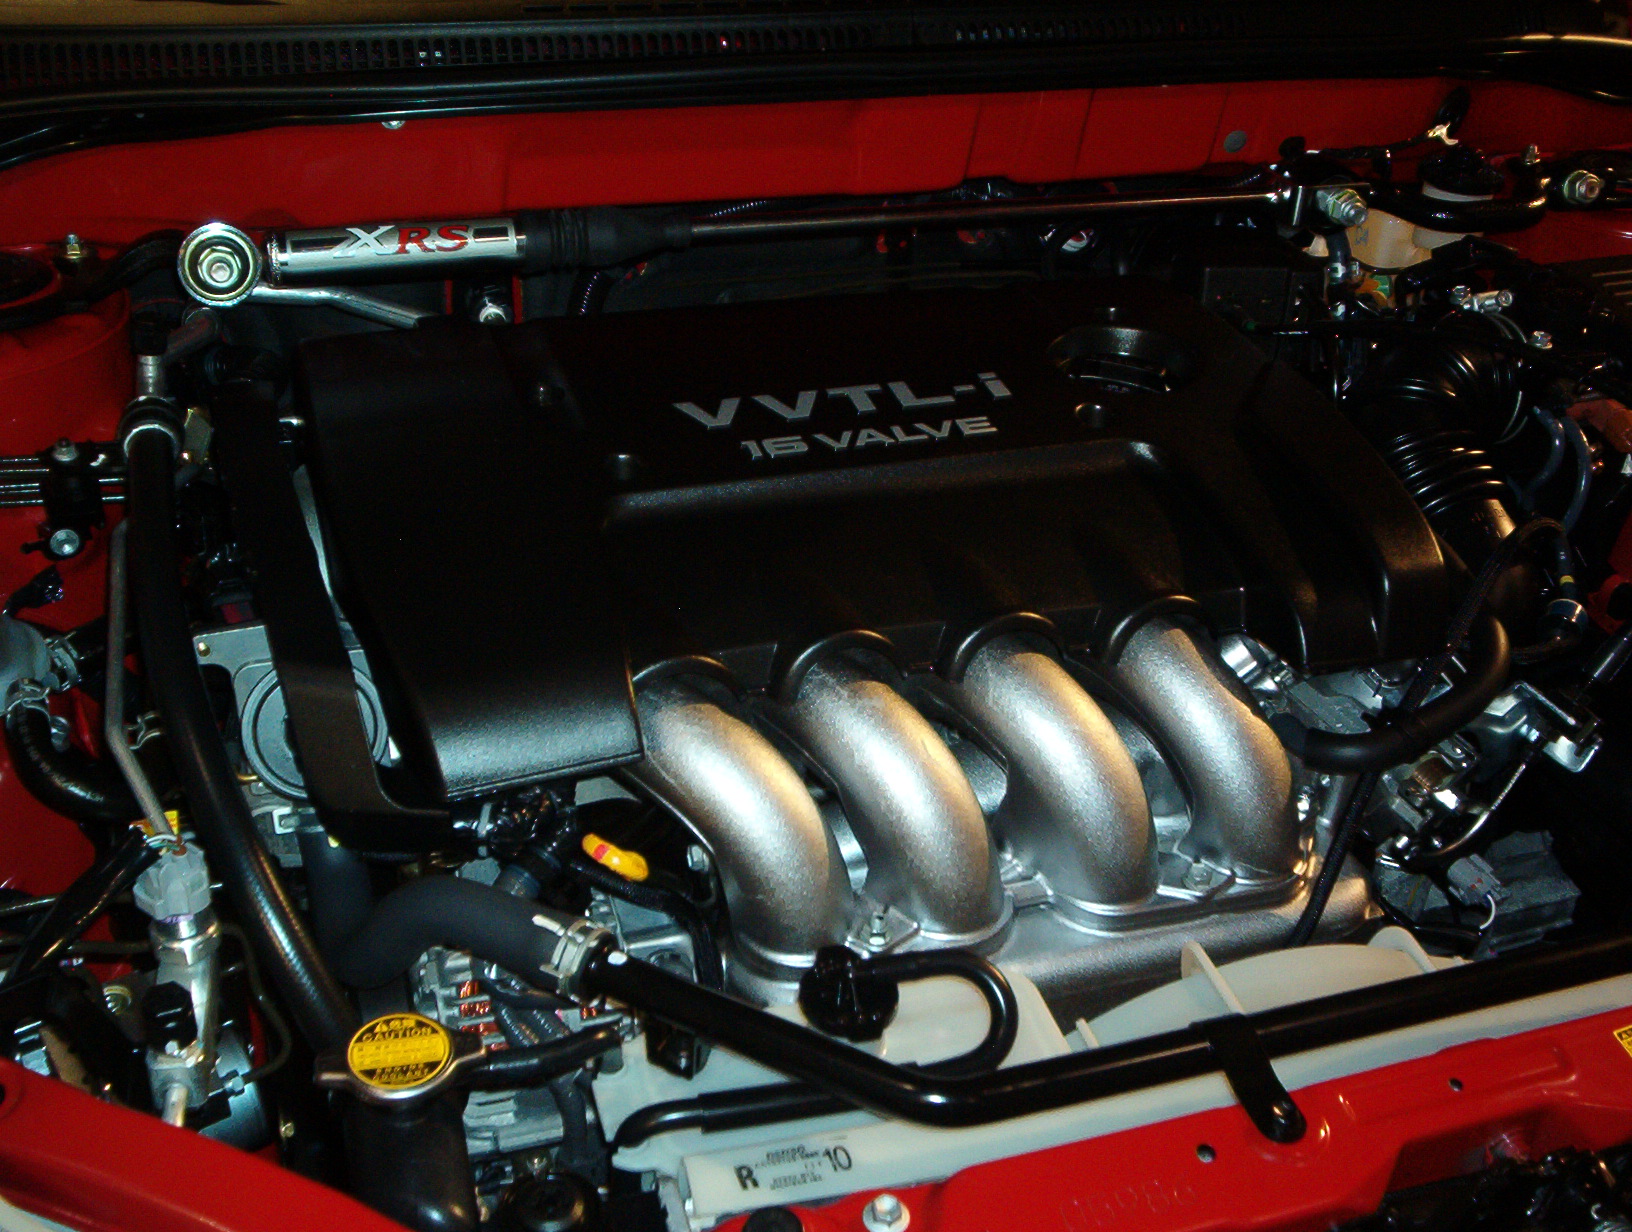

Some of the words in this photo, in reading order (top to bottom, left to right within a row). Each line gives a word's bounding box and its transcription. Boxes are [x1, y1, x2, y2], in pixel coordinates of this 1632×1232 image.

[332, 224, 469, 259] XRS
[672, 371, 1012, 430] VVTL-i
[740, 435, 809, 461] 16
[812, 416, 999, 452] VALVE
[361, 1026, 433, 1043] CAUTION
[822, 1145, 852, 1173] 10
[733, 1164, 760, 1190] R
